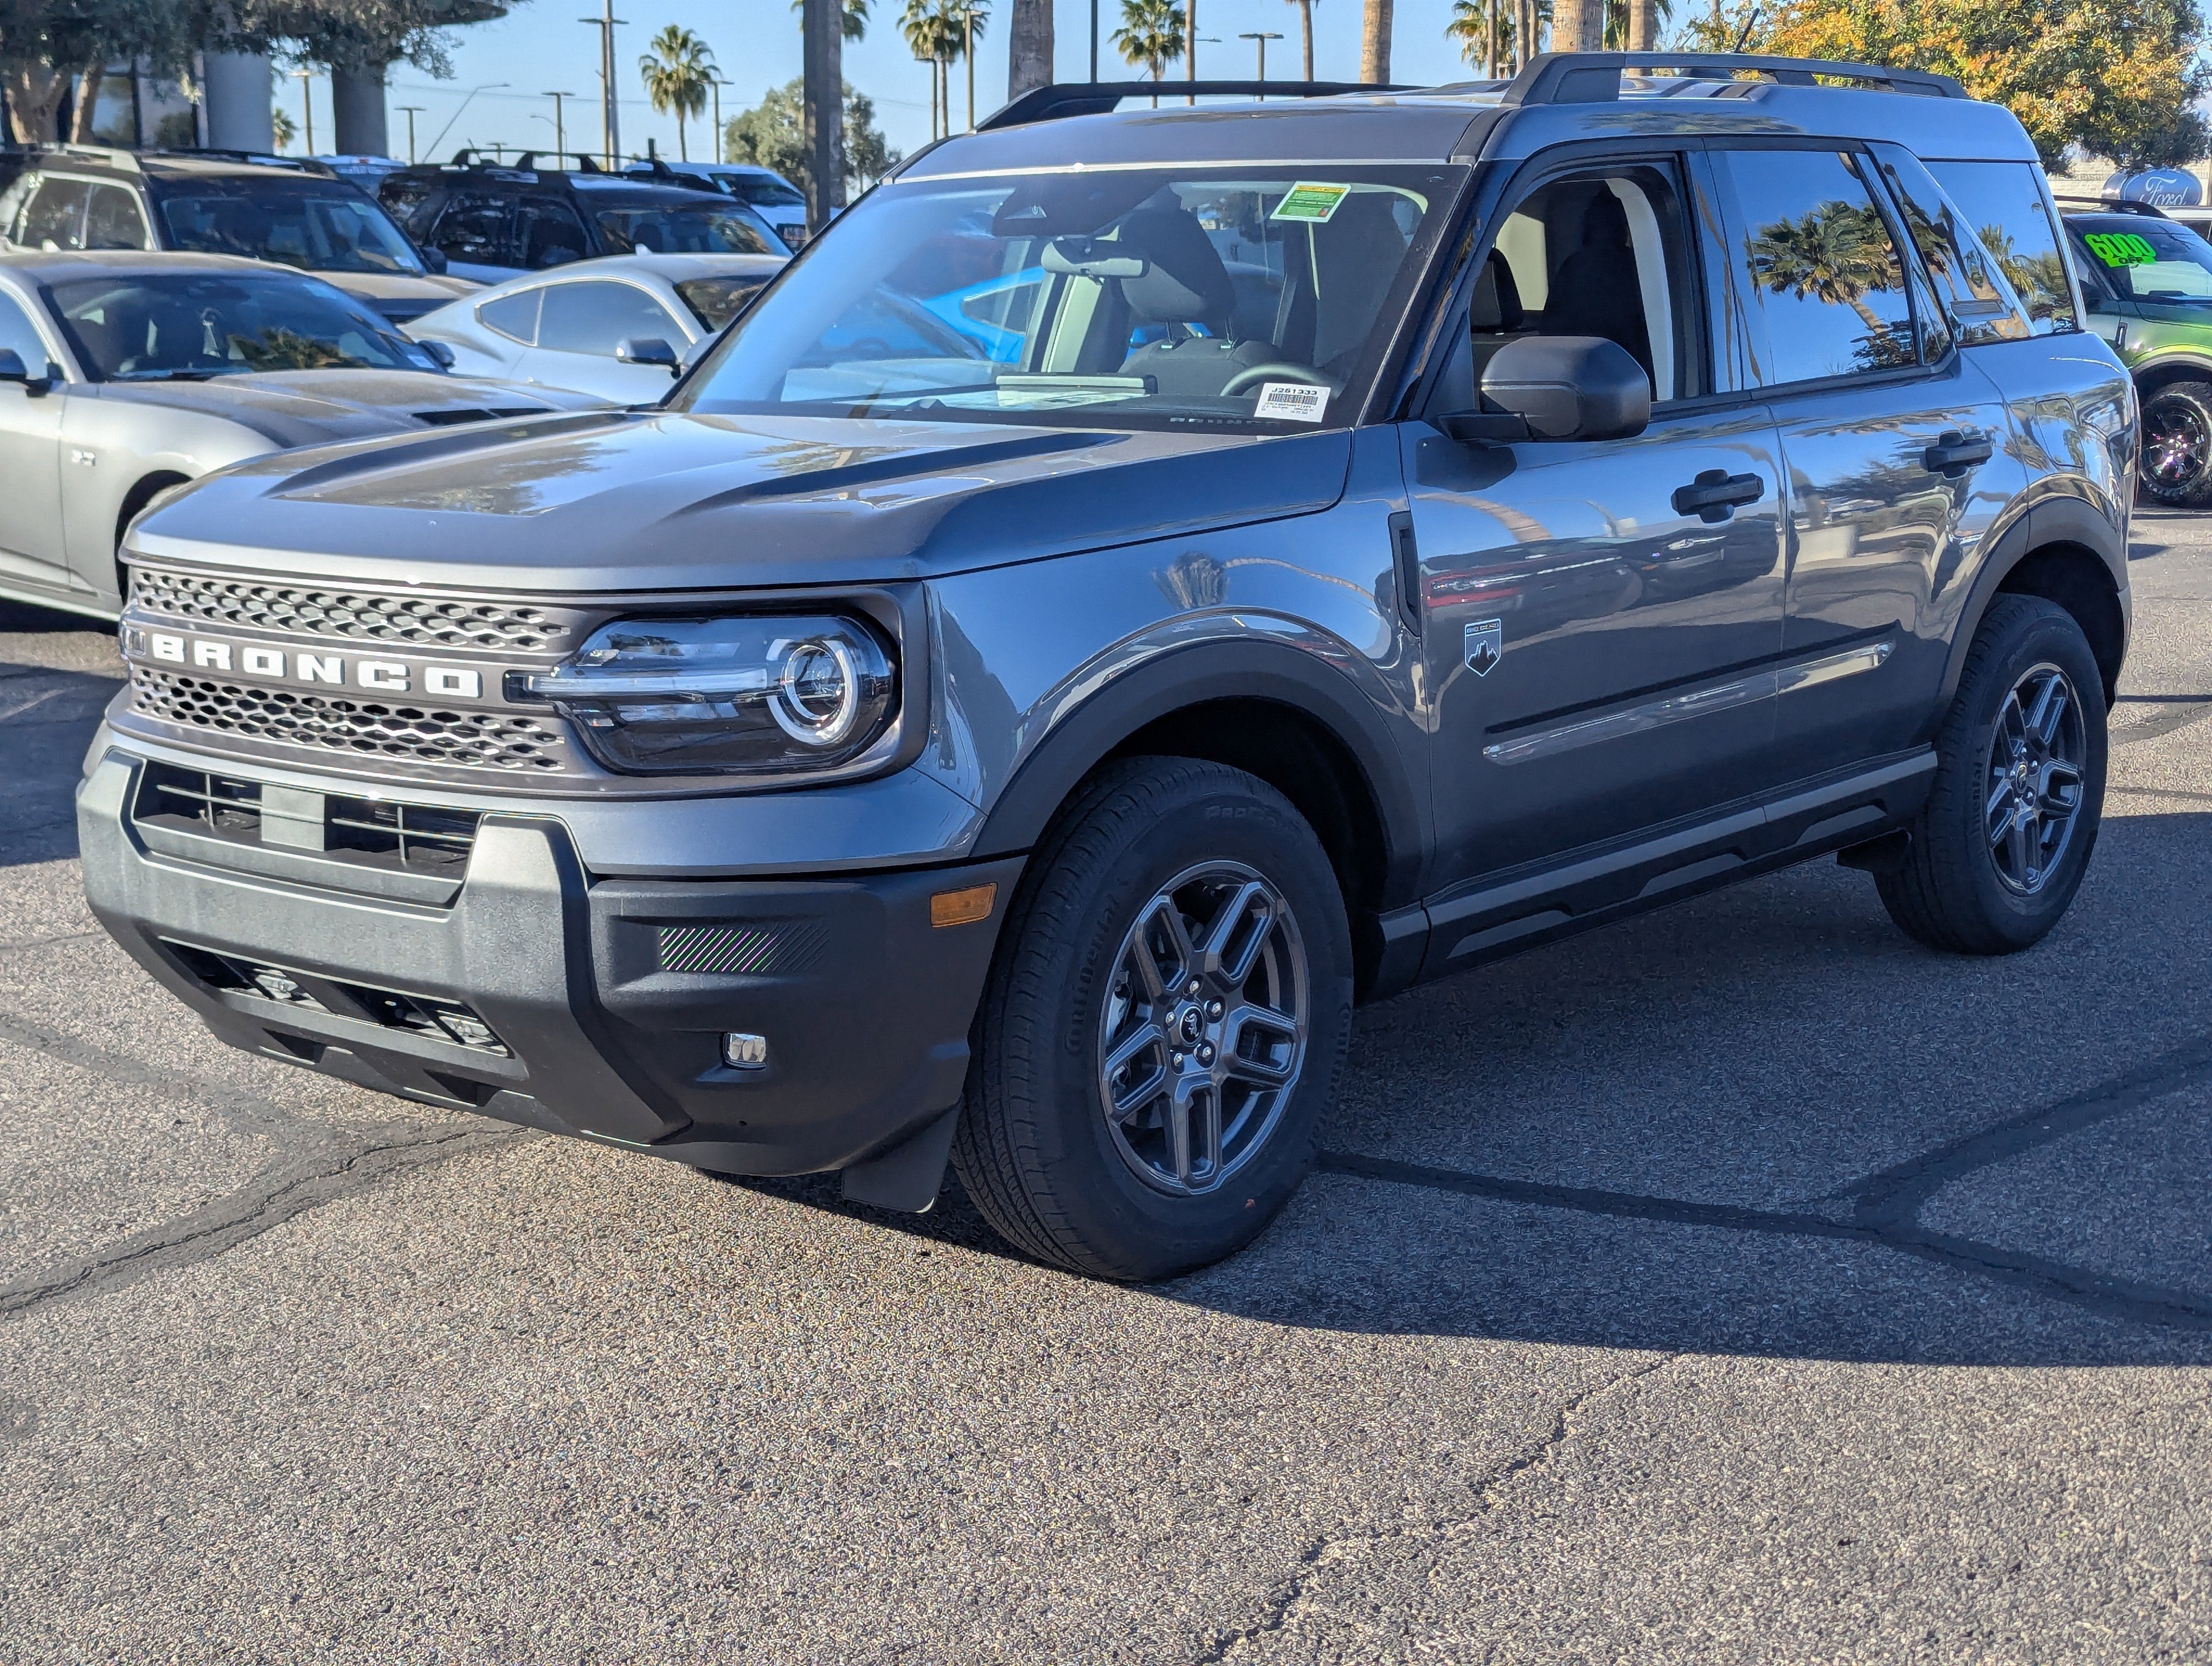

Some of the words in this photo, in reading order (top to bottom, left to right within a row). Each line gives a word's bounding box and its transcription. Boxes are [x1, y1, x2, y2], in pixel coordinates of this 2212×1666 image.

[2139, 176, 2189, 205] Ford
[2084, 233, 2156, 259] 6000
[152, 633, 481, 698] BRONCO
